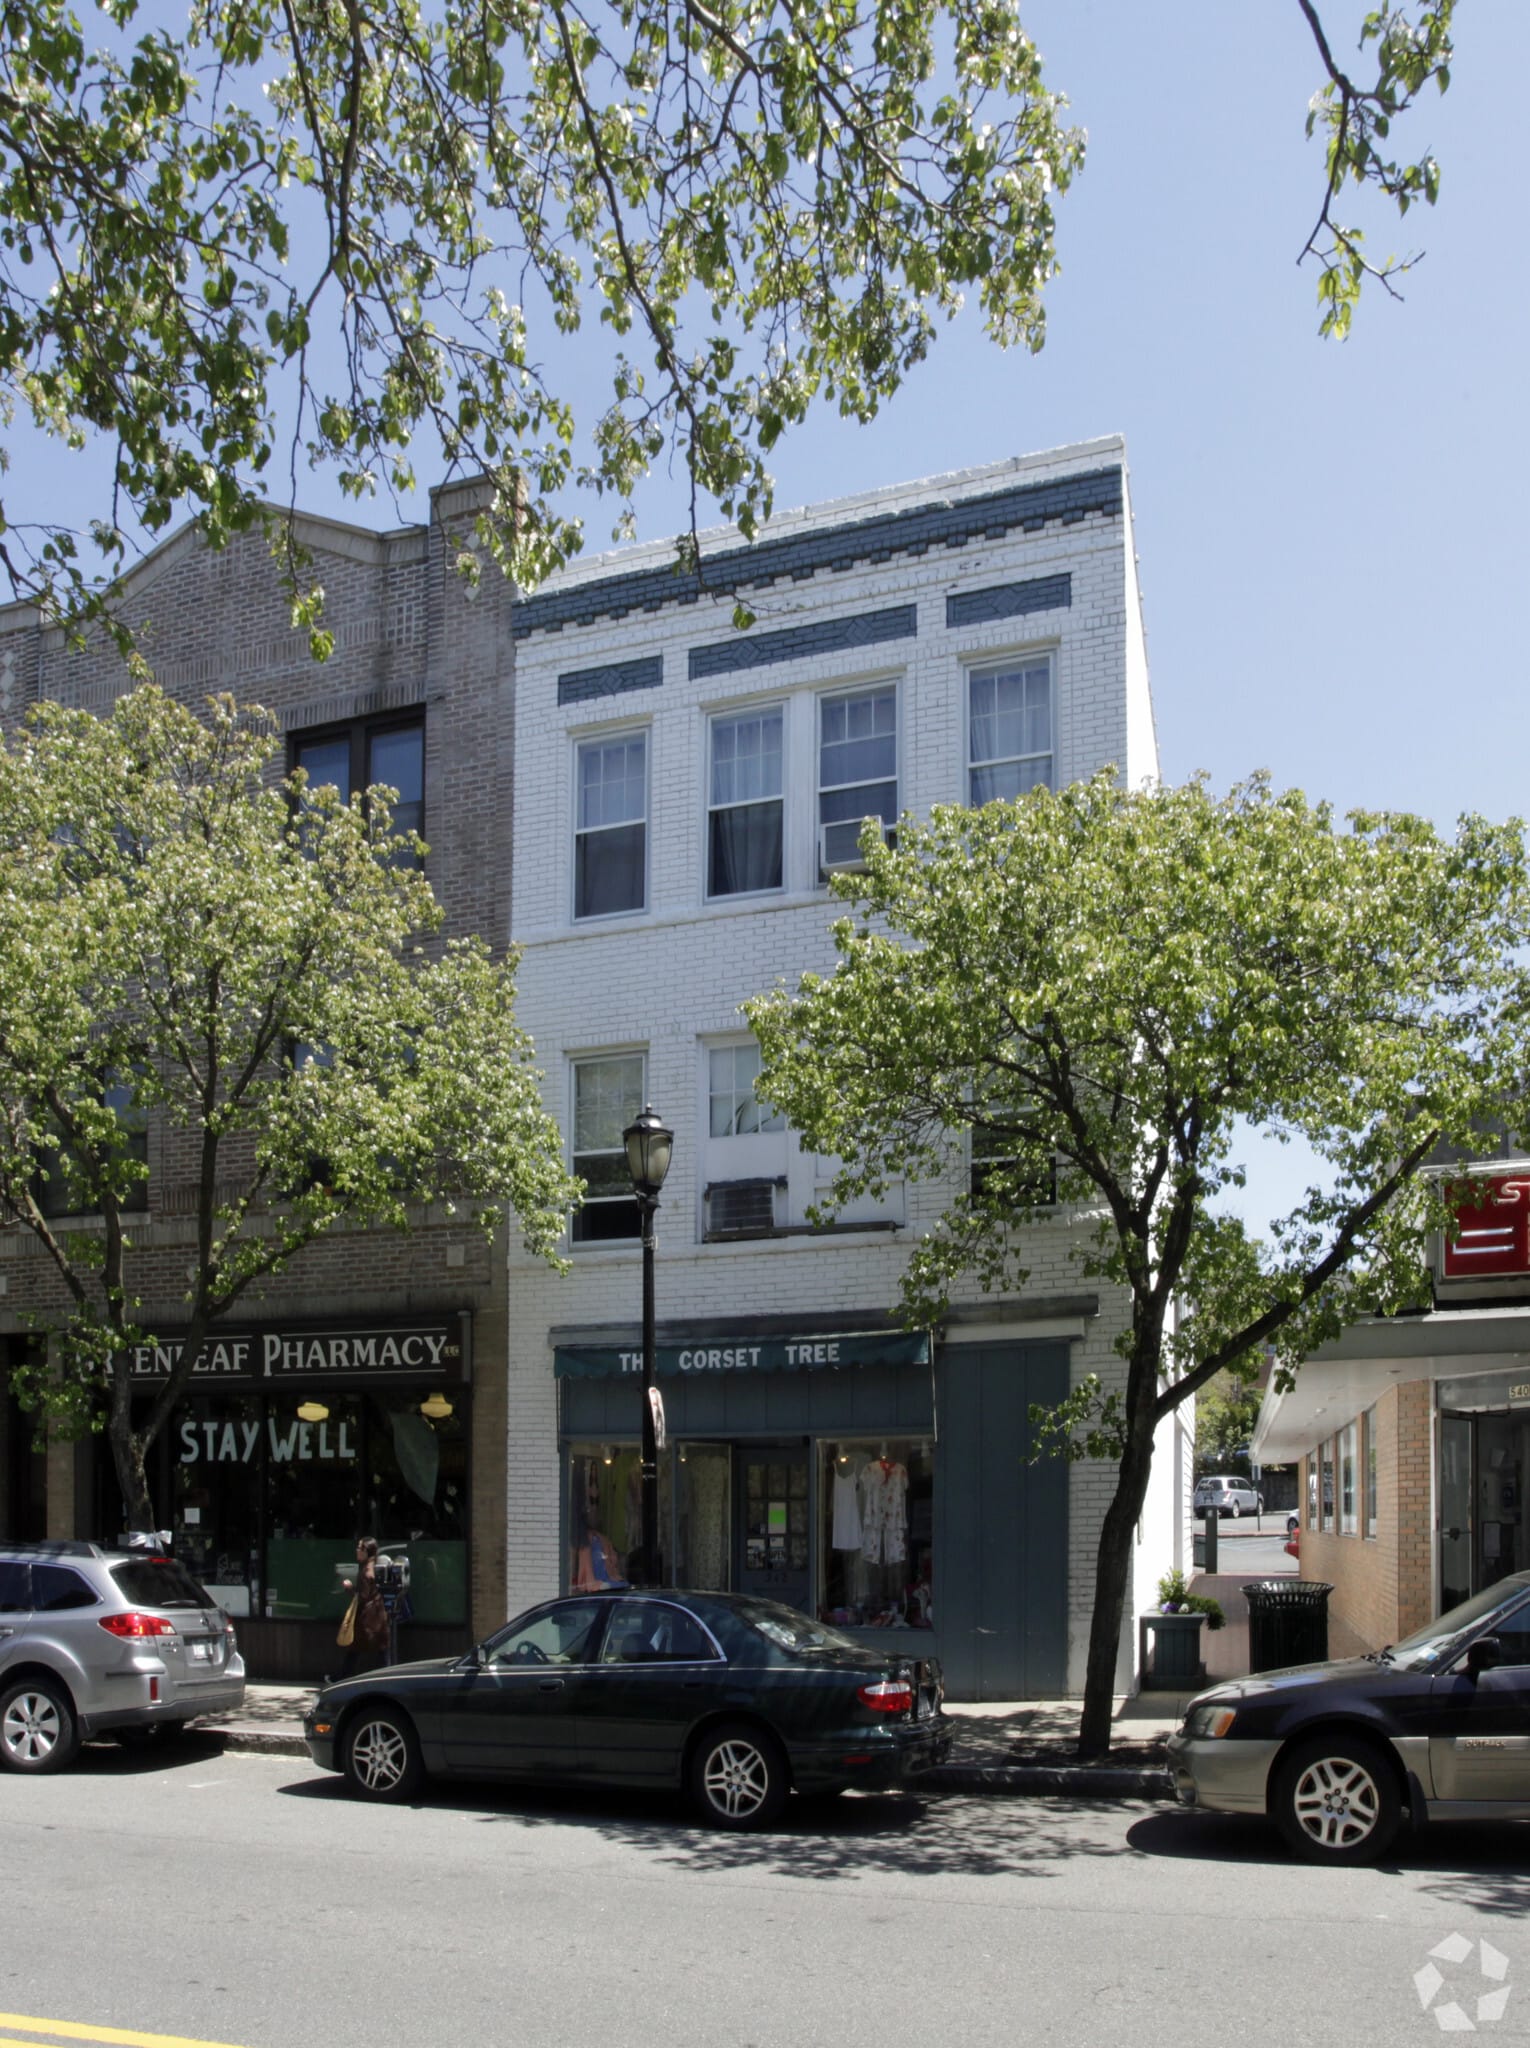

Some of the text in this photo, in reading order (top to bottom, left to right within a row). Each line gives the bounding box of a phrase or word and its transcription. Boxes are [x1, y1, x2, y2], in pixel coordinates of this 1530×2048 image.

[264, 1334, 447, 1377] PHARMACY
[618, 1343, 840, 1372] TH CORSET TREE
[180, 1416, 356, 1464] STAY WELL
